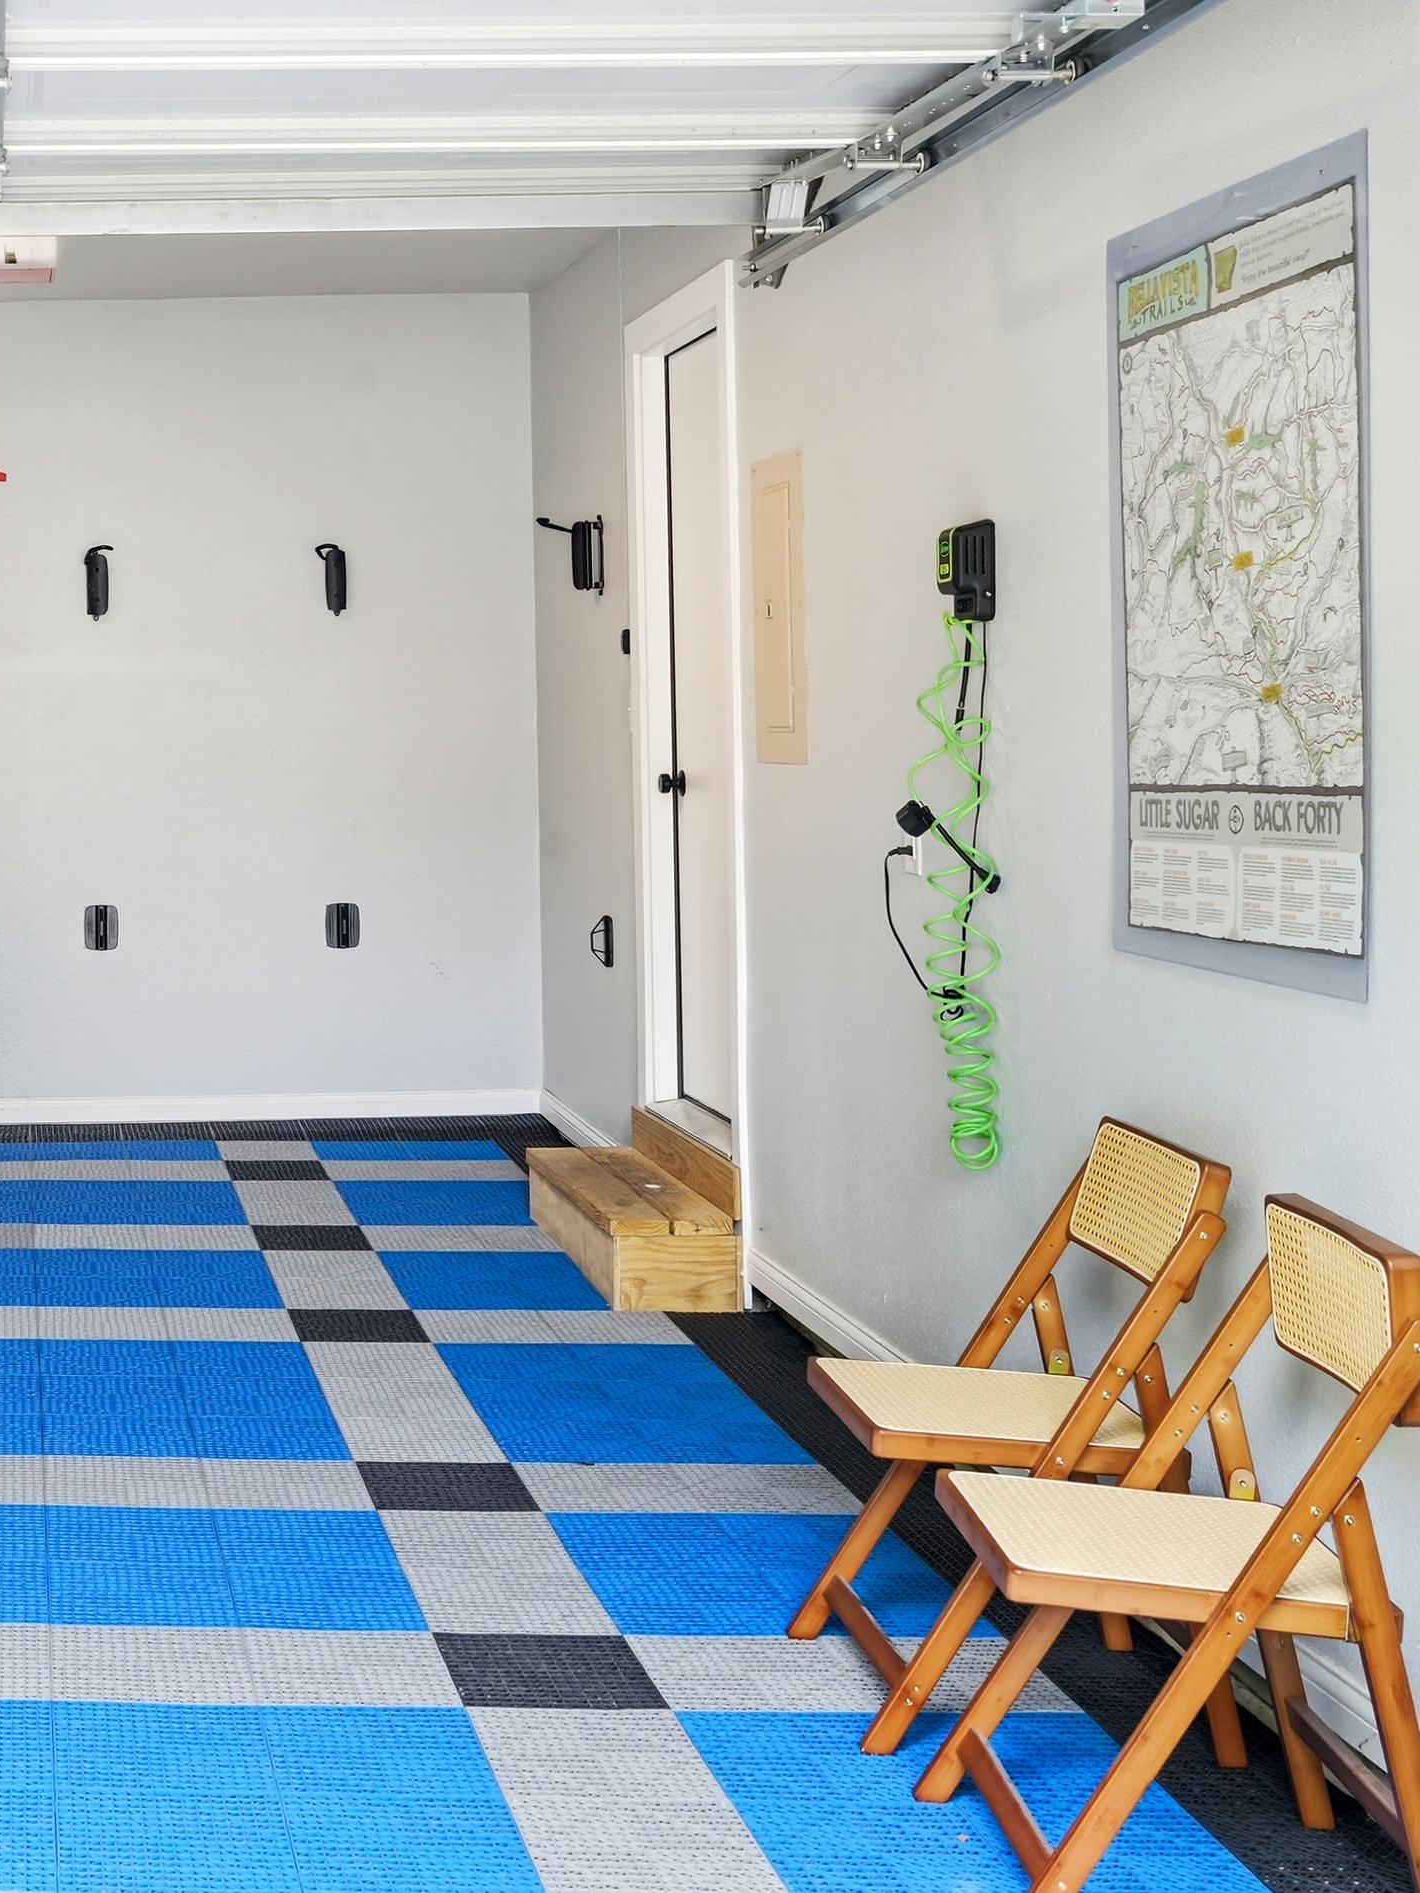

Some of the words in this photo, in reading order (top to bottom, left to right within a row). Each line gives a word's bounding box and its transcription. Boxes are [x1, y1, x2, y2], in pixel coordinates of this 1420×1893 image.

[1141, 294, 1184, 325] TRAILS
[1138, 798, 1172, 828] LITTLE
[1175, 799, 1220, 831] SUGAR
[1254, 799, 1292, 833] BACK
[1296, 801, 1344, 835] FORTY
